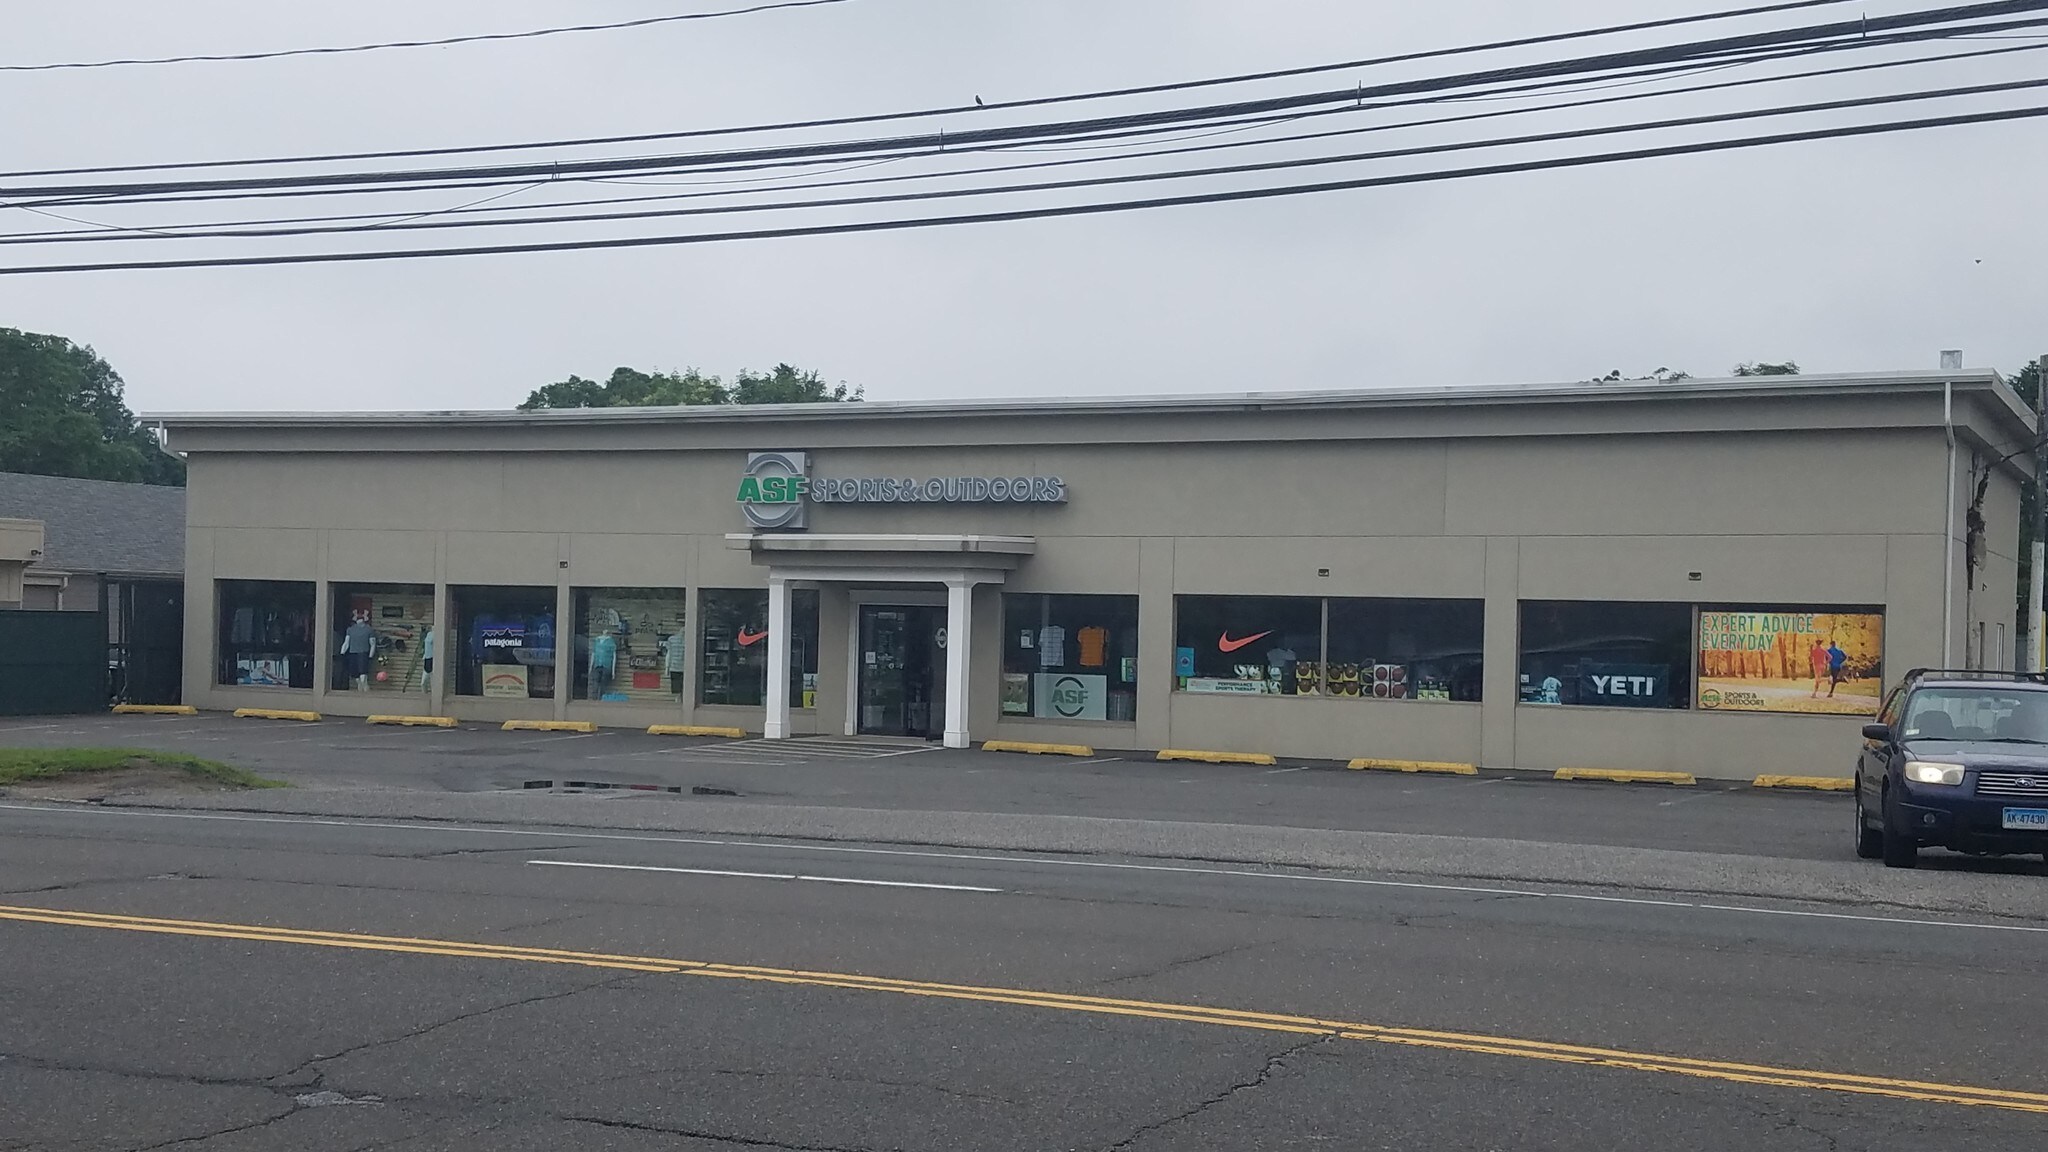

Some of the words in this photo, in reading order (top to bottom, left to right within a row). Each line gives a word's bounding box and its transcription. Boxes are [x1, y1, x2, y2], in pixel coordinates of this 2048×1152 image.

[736, 476, 809, 504] ASF
[811, 476, 898, 503] SPORTS
[899, 477, 920, 502] &
[922, 476, 1062, 502] OUTDOORS
[1701, 615, 1756, 632] EXPERT
[484, 638, 523, 648] patagonia
[1701, 633, 1775, 651] EVERYDAY
[1591, 674, 1654, 696] YETI
[1051, 689, 1089, 704] ASF
[1723, 698, 1765, 706] OUTDOORS
[1724, 691, 1751, 699] SPORTS
